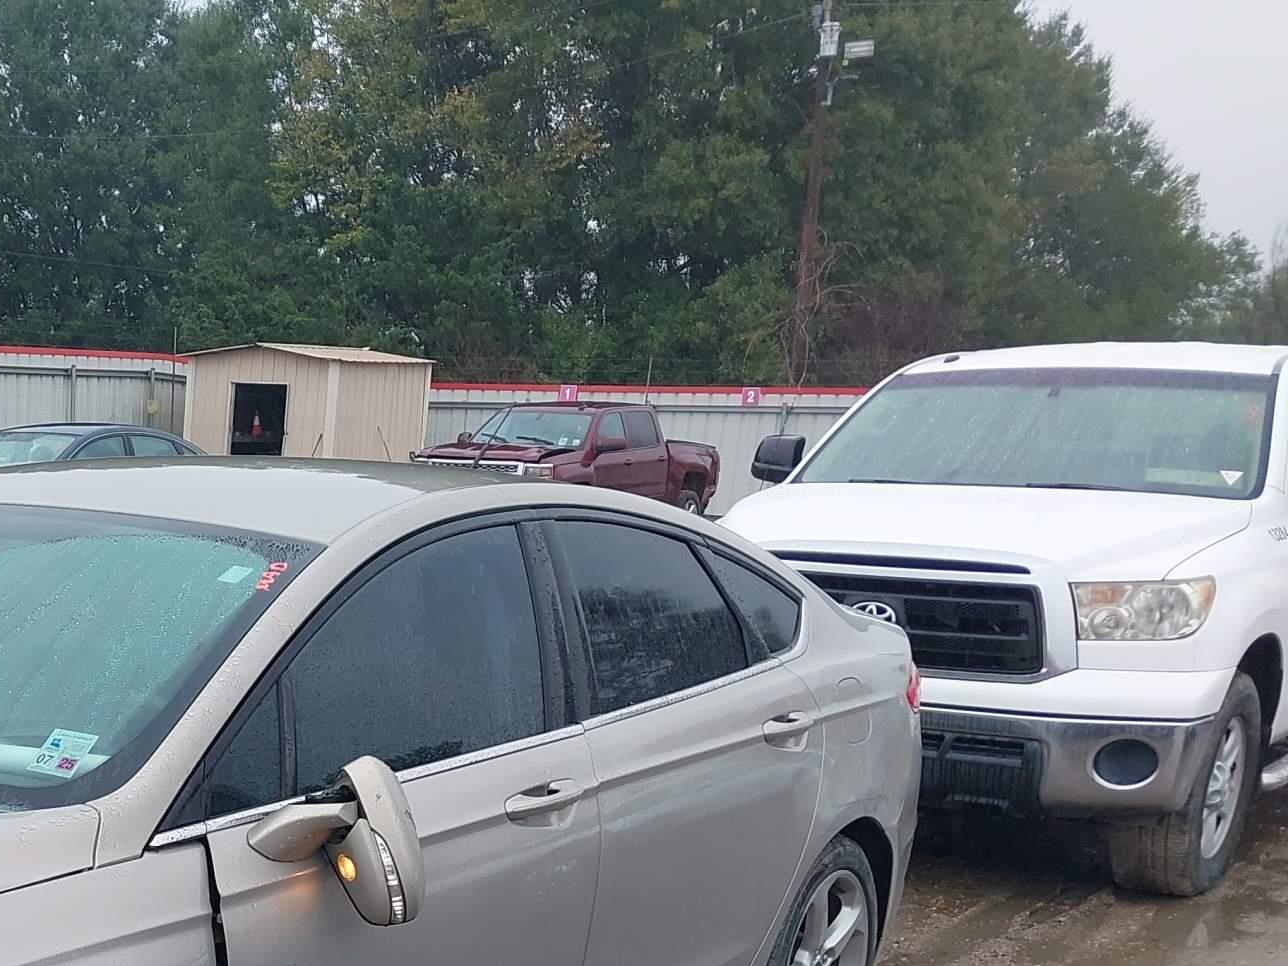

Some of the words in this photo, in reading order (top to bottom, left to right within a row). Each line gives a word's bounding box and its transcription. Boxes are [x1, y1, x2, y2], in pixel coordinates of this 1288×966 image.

[746, 390, 755, 403] 2
[35, 753, 54, 765] 07
[57, 756, 78, 770] 25
